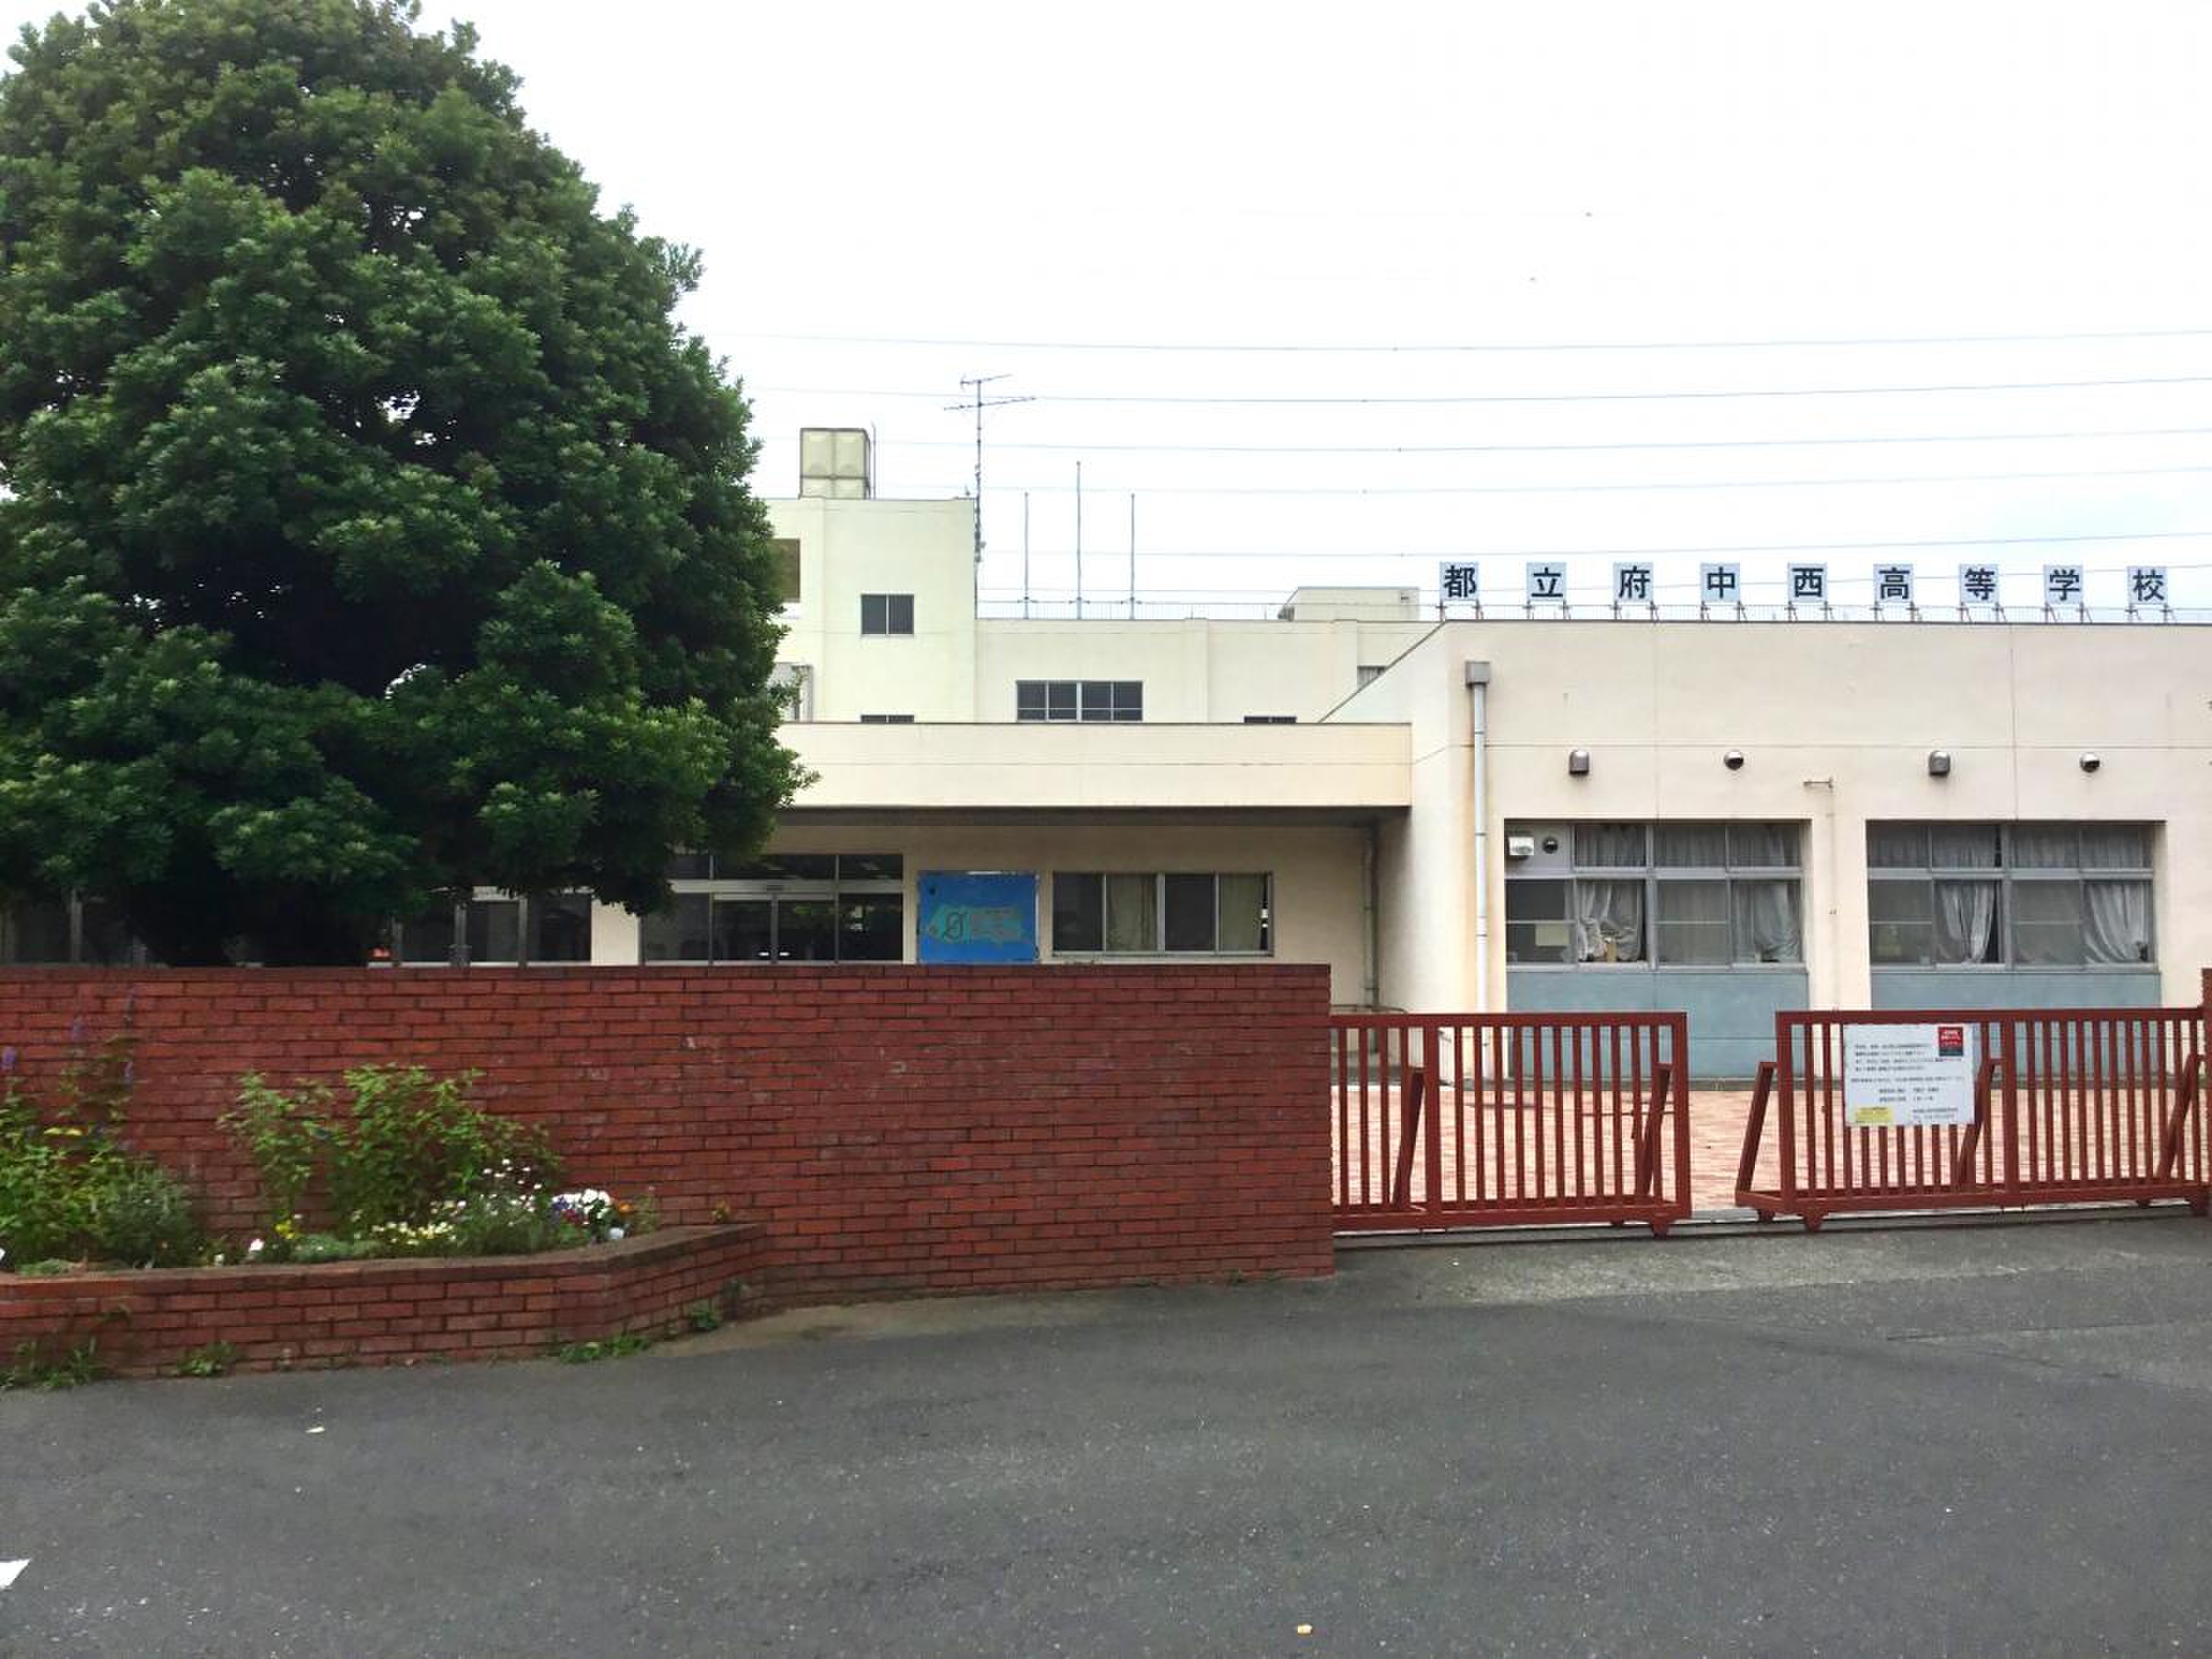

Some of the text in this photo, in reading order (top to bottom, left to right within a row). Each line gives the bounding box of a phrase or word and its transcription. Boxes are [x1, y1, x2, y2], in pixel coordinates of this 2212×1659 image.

[1443, 565, 2166, 602] 都立府中西高等学校
